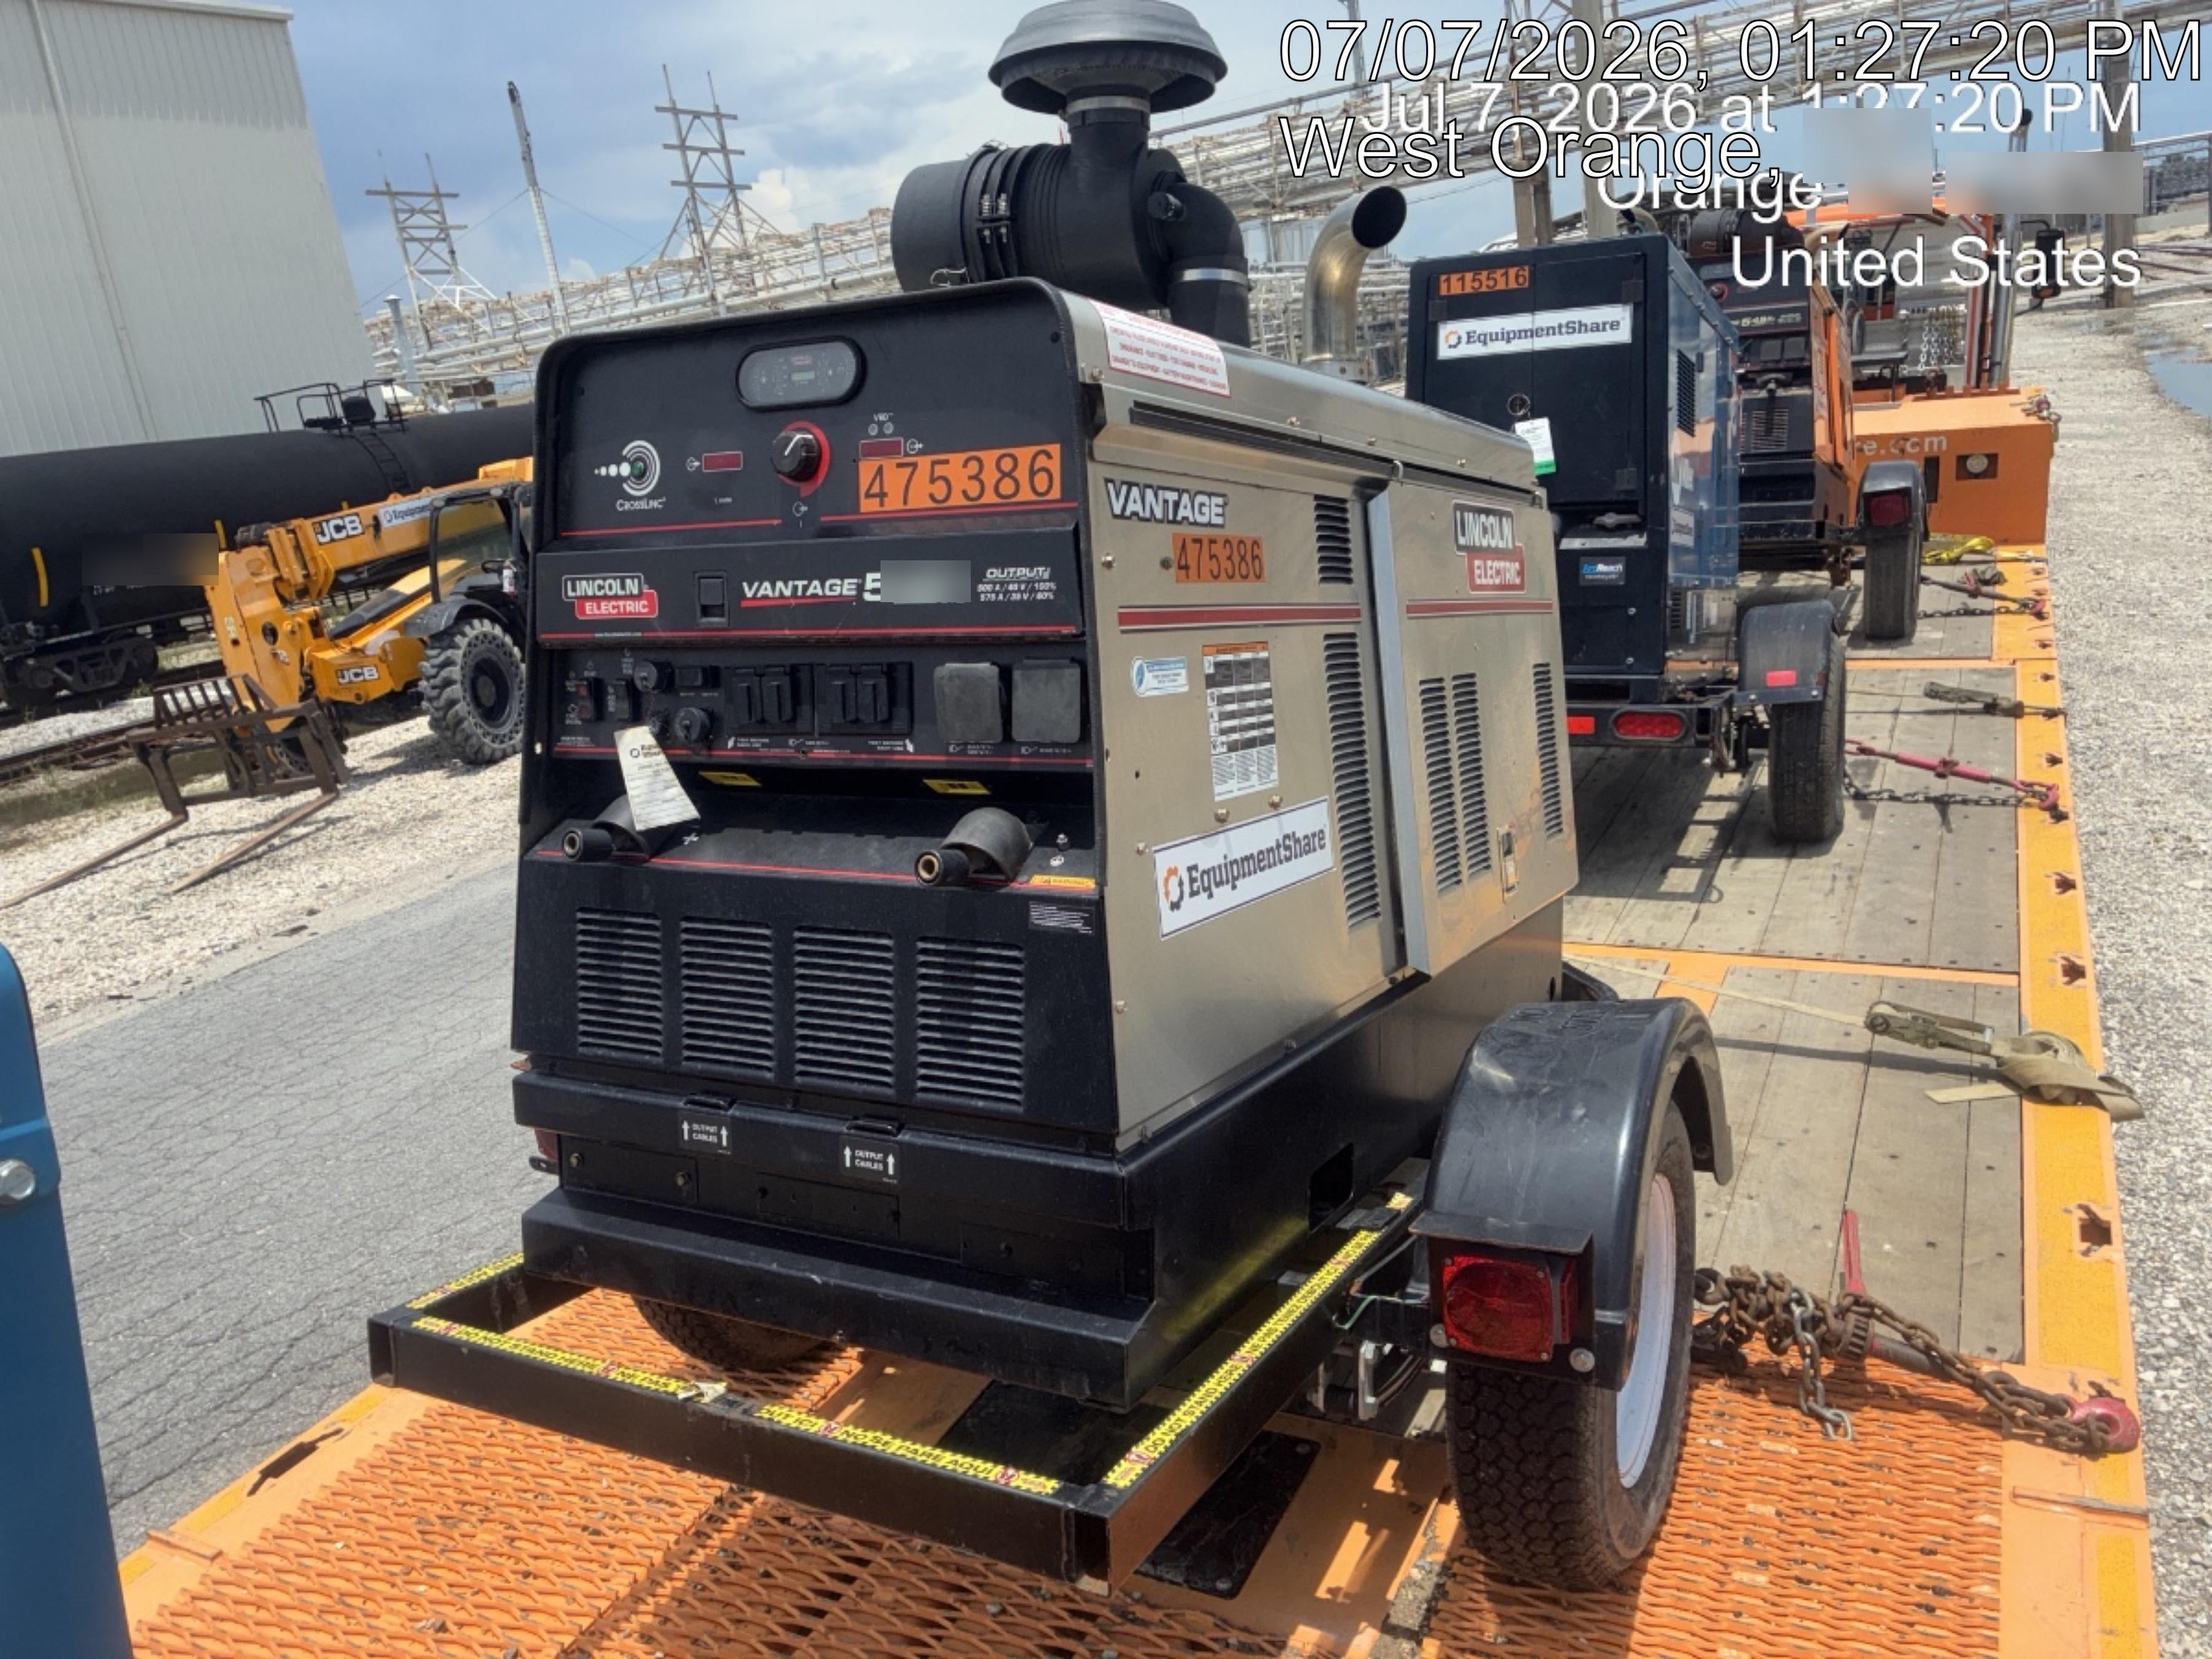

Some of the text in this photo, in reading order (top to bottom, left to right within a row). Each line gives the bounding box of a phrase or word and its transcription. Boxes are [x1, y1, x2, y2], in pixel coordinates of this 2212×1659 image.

[1441, 266, 1528, 294] 115516
[1464, 319, 1622, 347] EquipmentShare
[863, 449, 1054, 508] 475386
[1107, 482, 1225, 525] VANTAGE
[317, 517, 363, 544] JCB
[1456, 510, 1513, 550] LINCOLN
[1177, 537, 1264, 580] 475386
[1473, 559, 1522, 586] ELECTRIC
[567, 577, 640, 597] LINCOLN
[741, 578, 858, 598] VANTAGE
[584, 599, 649, 614] ELECTRIC
[338, 665, 379, 684] JCB
[1186, 827, 1327, 900] EquipmentShare
[1143, 1435, 1166, 1454] DO
[1161, 1416, 1186, 1438] NOT
[1182, 1386, 1219, 1418] STAND
